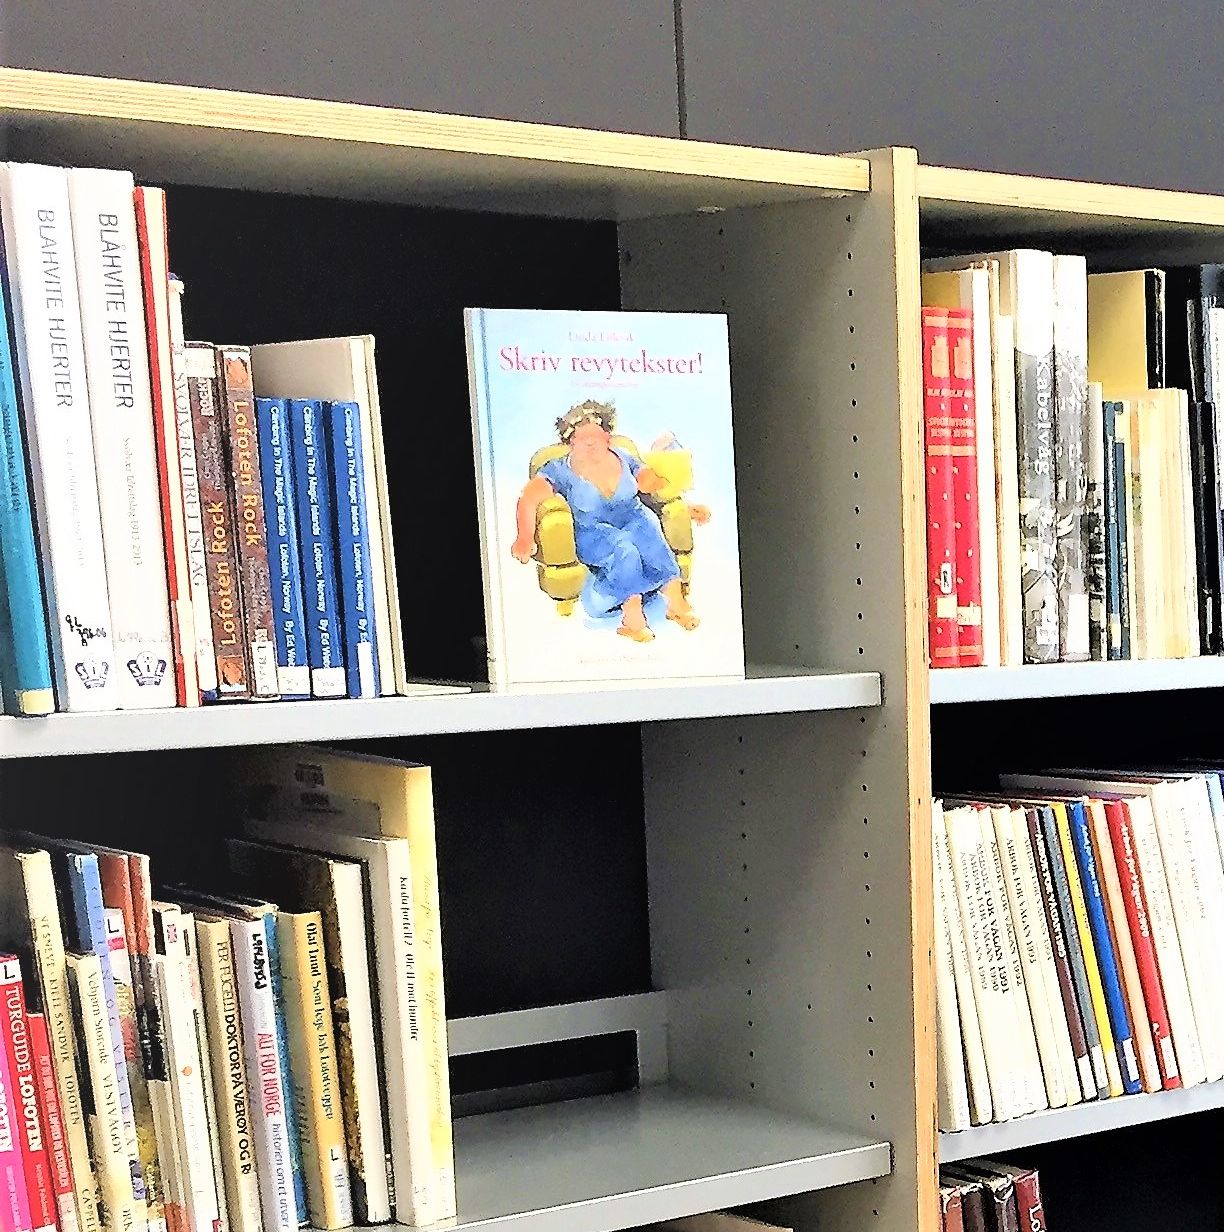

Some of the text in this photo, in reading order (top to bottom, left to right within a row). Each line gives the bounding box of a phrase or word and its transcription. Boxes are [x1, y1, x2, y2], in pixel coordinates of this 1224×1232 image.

[109, 318, 134, 410] HJERTER
[500, 345, 704, 379] Skriv revytekster!
[1033, 358, 1052, 475] Kabelvåg
[233, 400, 262, 546] Lofoten Rock
[209, 500, 229, 553] Rock
[213, 562, 236, 647] Lofoten
[4, 986, 30, 1074] TURGUIDE
[19, 1074, 45, 1152] LOFOTEN
[256, 1031, 275, 1052] ALT
[259, 1052, 277, 1075] FOR
[223, 1013, 241, 1072] DOKTOR
[238, 1138, 252, 1161] OG
[261, 1077, 281, 1118] NORGE
